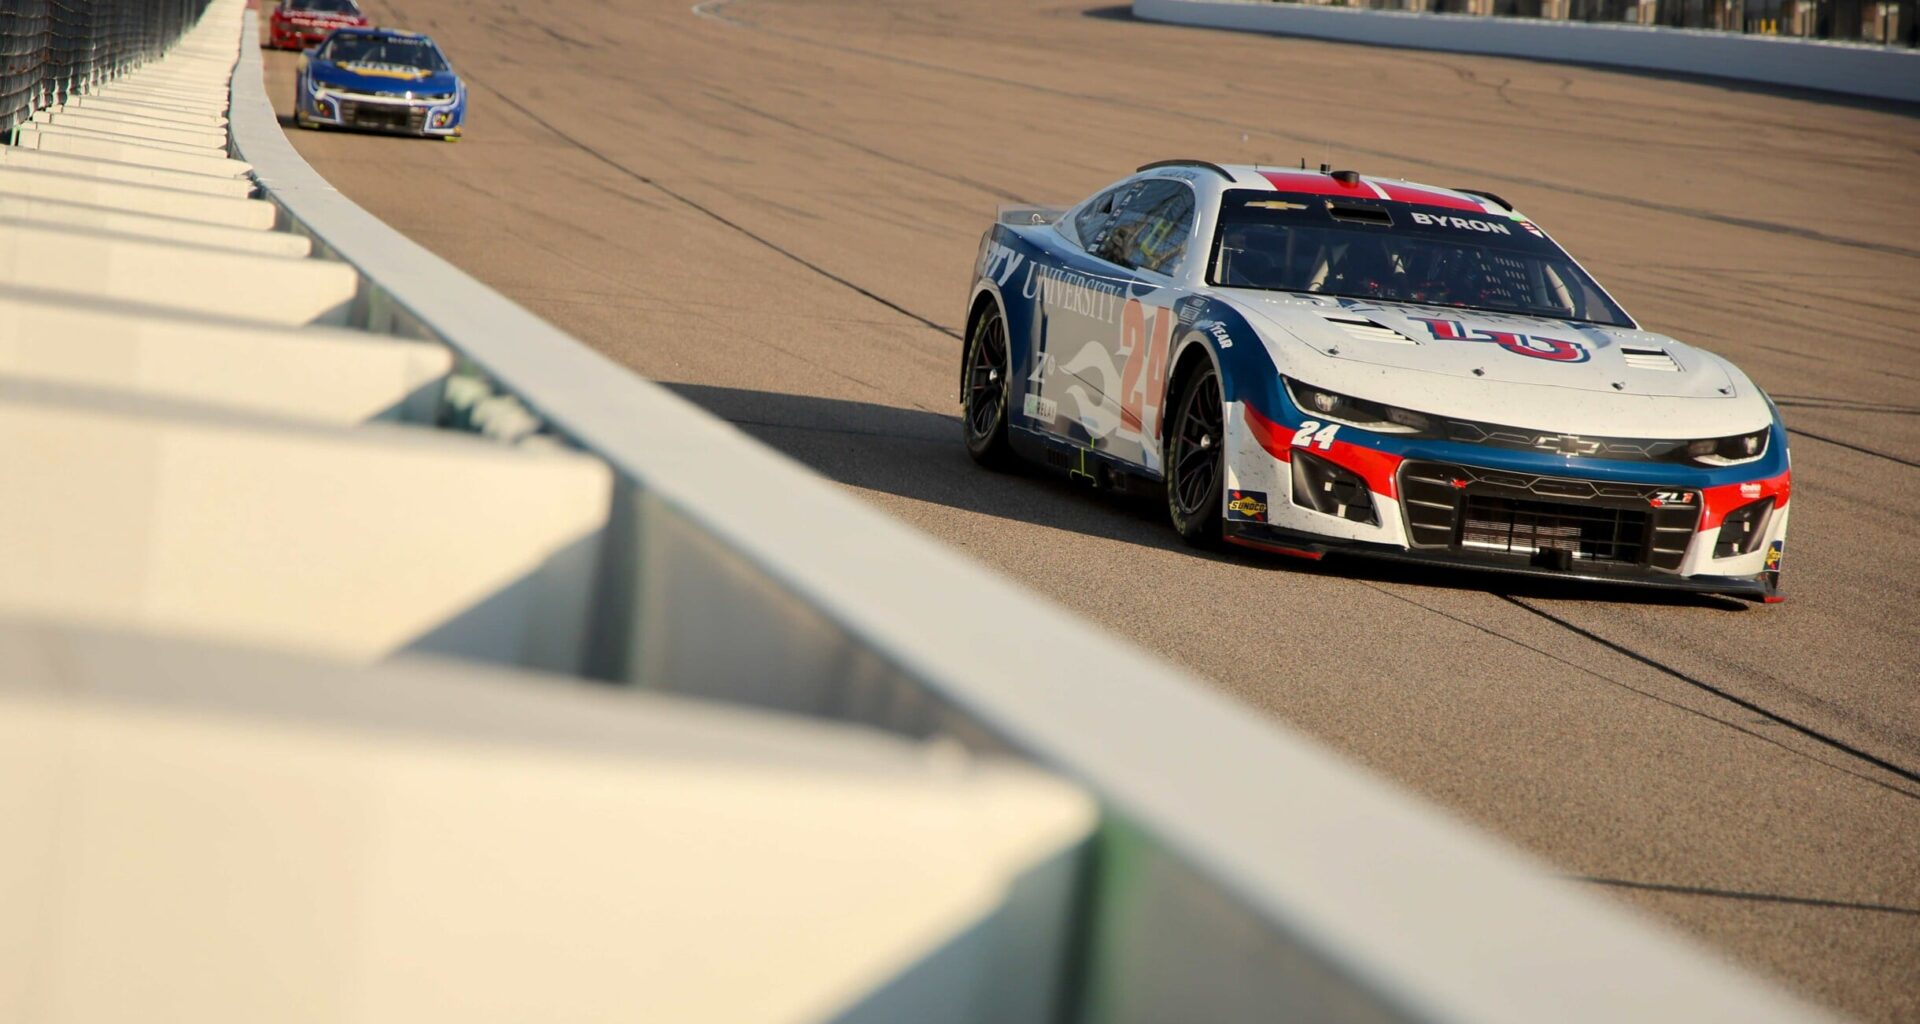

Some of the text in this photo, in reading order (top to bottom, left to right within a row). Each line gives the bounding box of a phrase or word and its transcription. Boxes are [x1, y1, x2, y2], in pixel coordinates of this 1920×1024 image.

[1410, 212, 1511, 235] BYRON
[1022, 260, 1122, 324] UNIVERSITY
[1120, 297, 1171, 442] 24
[1290, 420, 1341, 450] 24
[1231, 501, 1265, 511] SUNOCO
